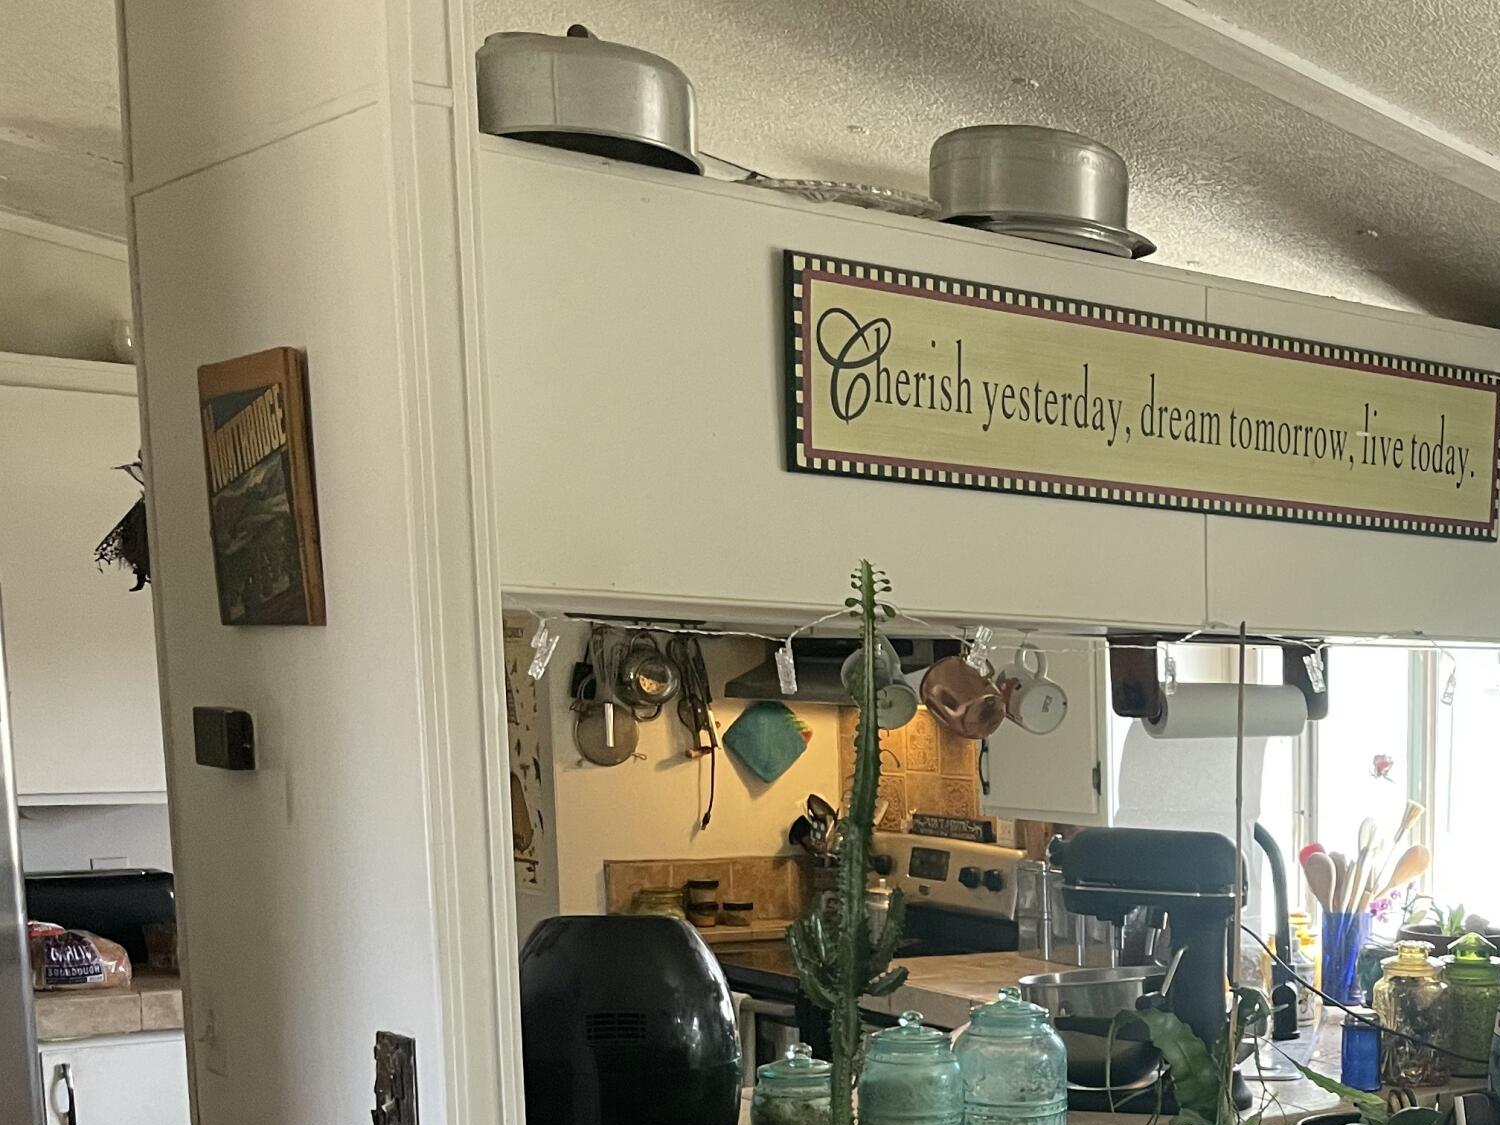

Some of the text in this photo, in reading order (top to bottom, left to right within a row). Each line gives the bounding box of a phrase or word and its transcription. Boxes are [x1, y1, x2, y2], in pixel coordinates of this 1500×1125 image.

[816, 307, 1475, 489] Cherish yesterday, dream tomorrow, live today.
